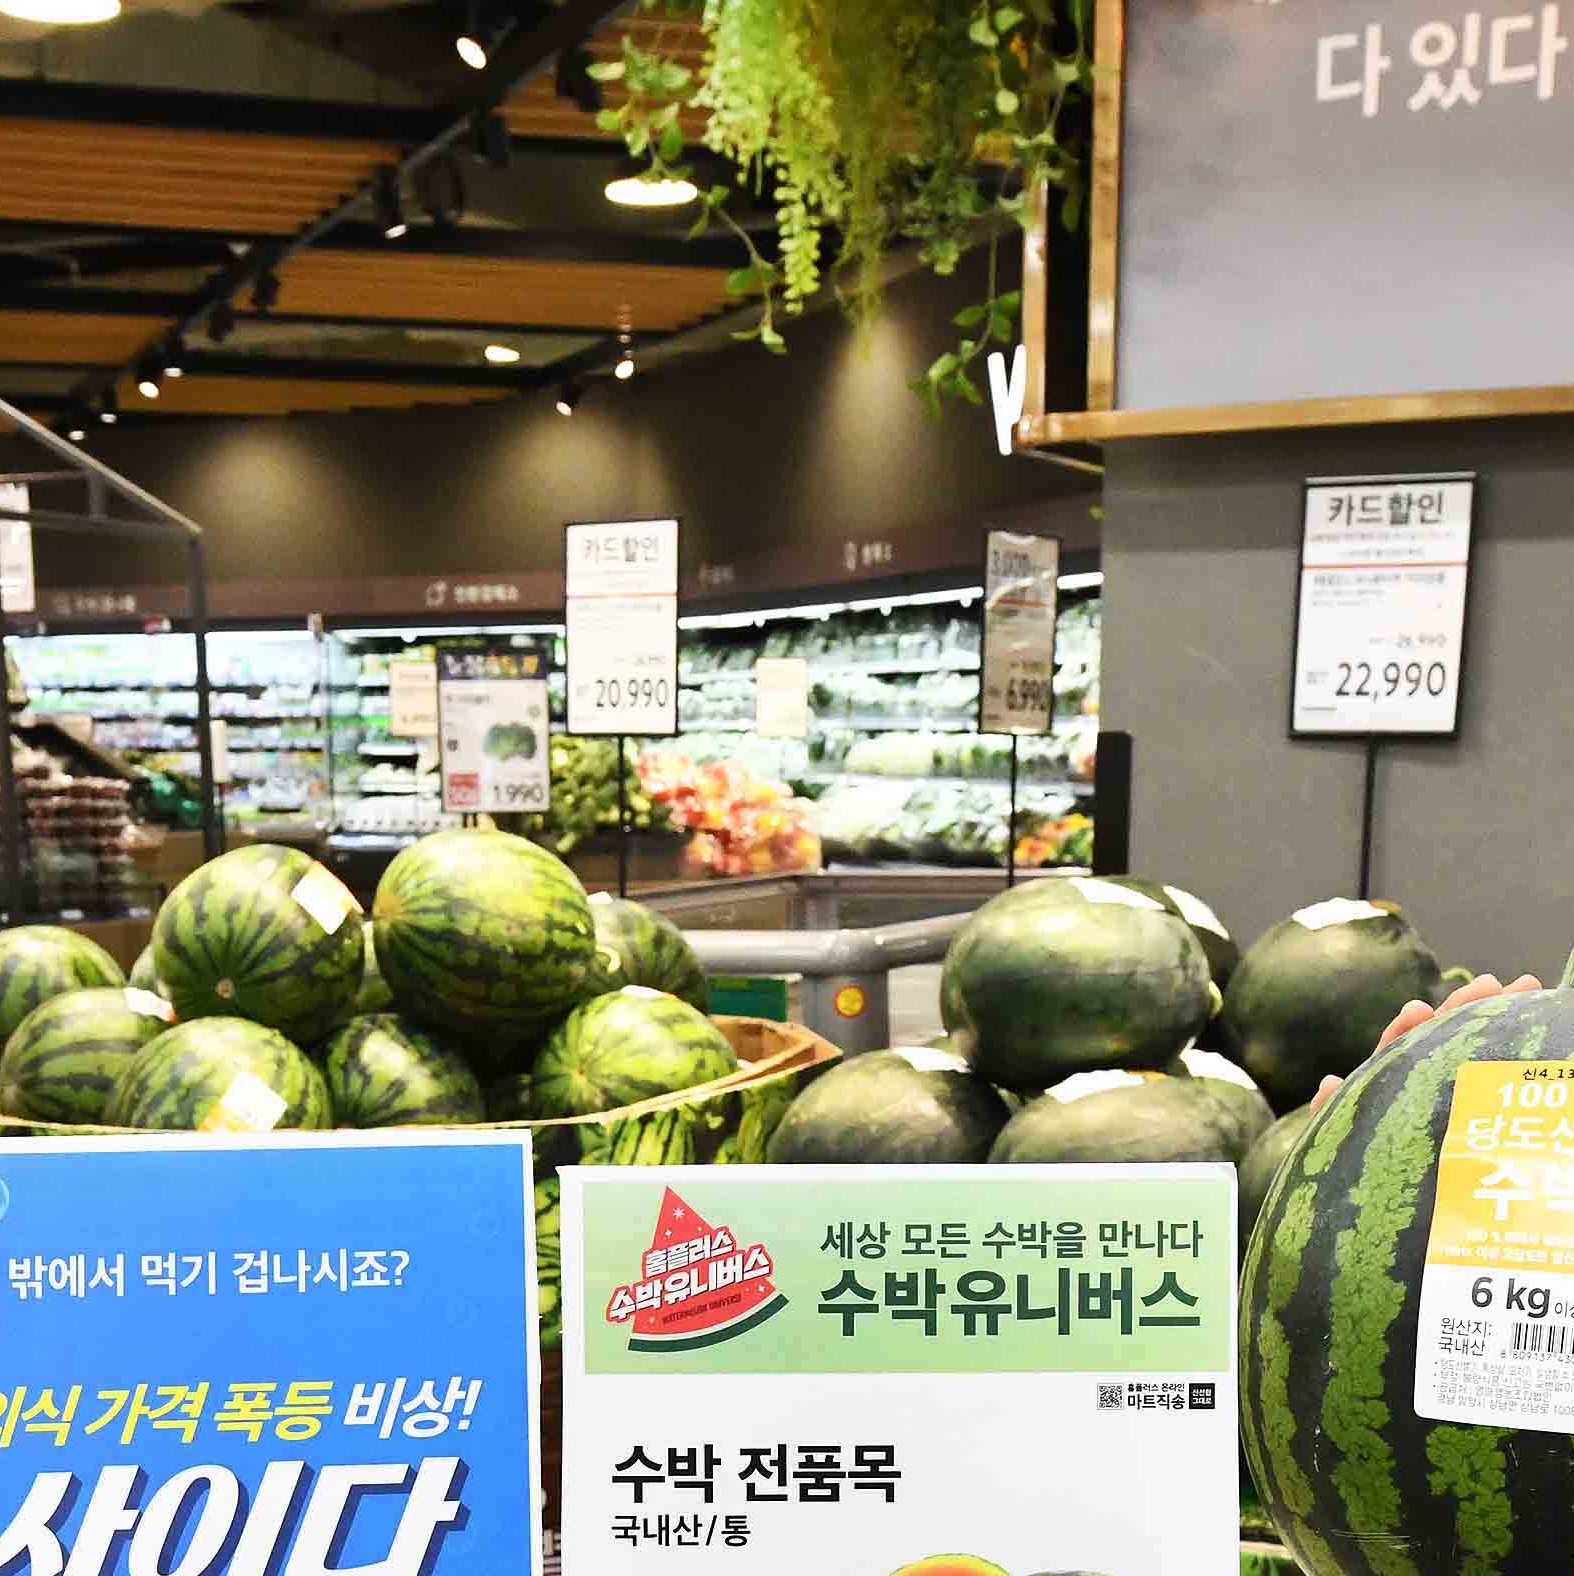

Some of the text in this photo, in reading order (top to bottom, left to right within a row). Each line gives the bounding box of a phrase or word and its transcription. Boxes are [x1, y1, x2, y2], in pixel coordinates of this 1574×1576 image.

[1315, 30, 1384, 119] 다
[1328, 491, 1444, 526] 카드할인
[1335, 662, 1446, 704] 22,990
[646, 1230, 733, 1277] 홈플러스
[819, 1219, 1203, 1260] 세상 모든 수박을 만나다
[7, 1249, 411, 1299] 밖에서 먹기 겁나시죠?
[609, 1247, 770, 1319] 수박유니버스
[817, 1267, 1201, 1337] 수박유니버스
[1471, 1277, 1493, 1308] 6
[1506, 1278, 1550, 1319] kg
[1438, 1337, 1486, 1356] 국내산
[1440, 1318, 1492, 1338] 원산지:
[1128, 1383, 1184, 1392] 홈플러스 온라인
[1128, 1394, 1185, 1410] 마트직송
[85, 1383, 209, 1444] 가격
[212, 1380, 335, 1442] 폭등
[342, 1377, 482, 1439] 비상!
[611, 1444, 902, 1504] 수박 전품목
